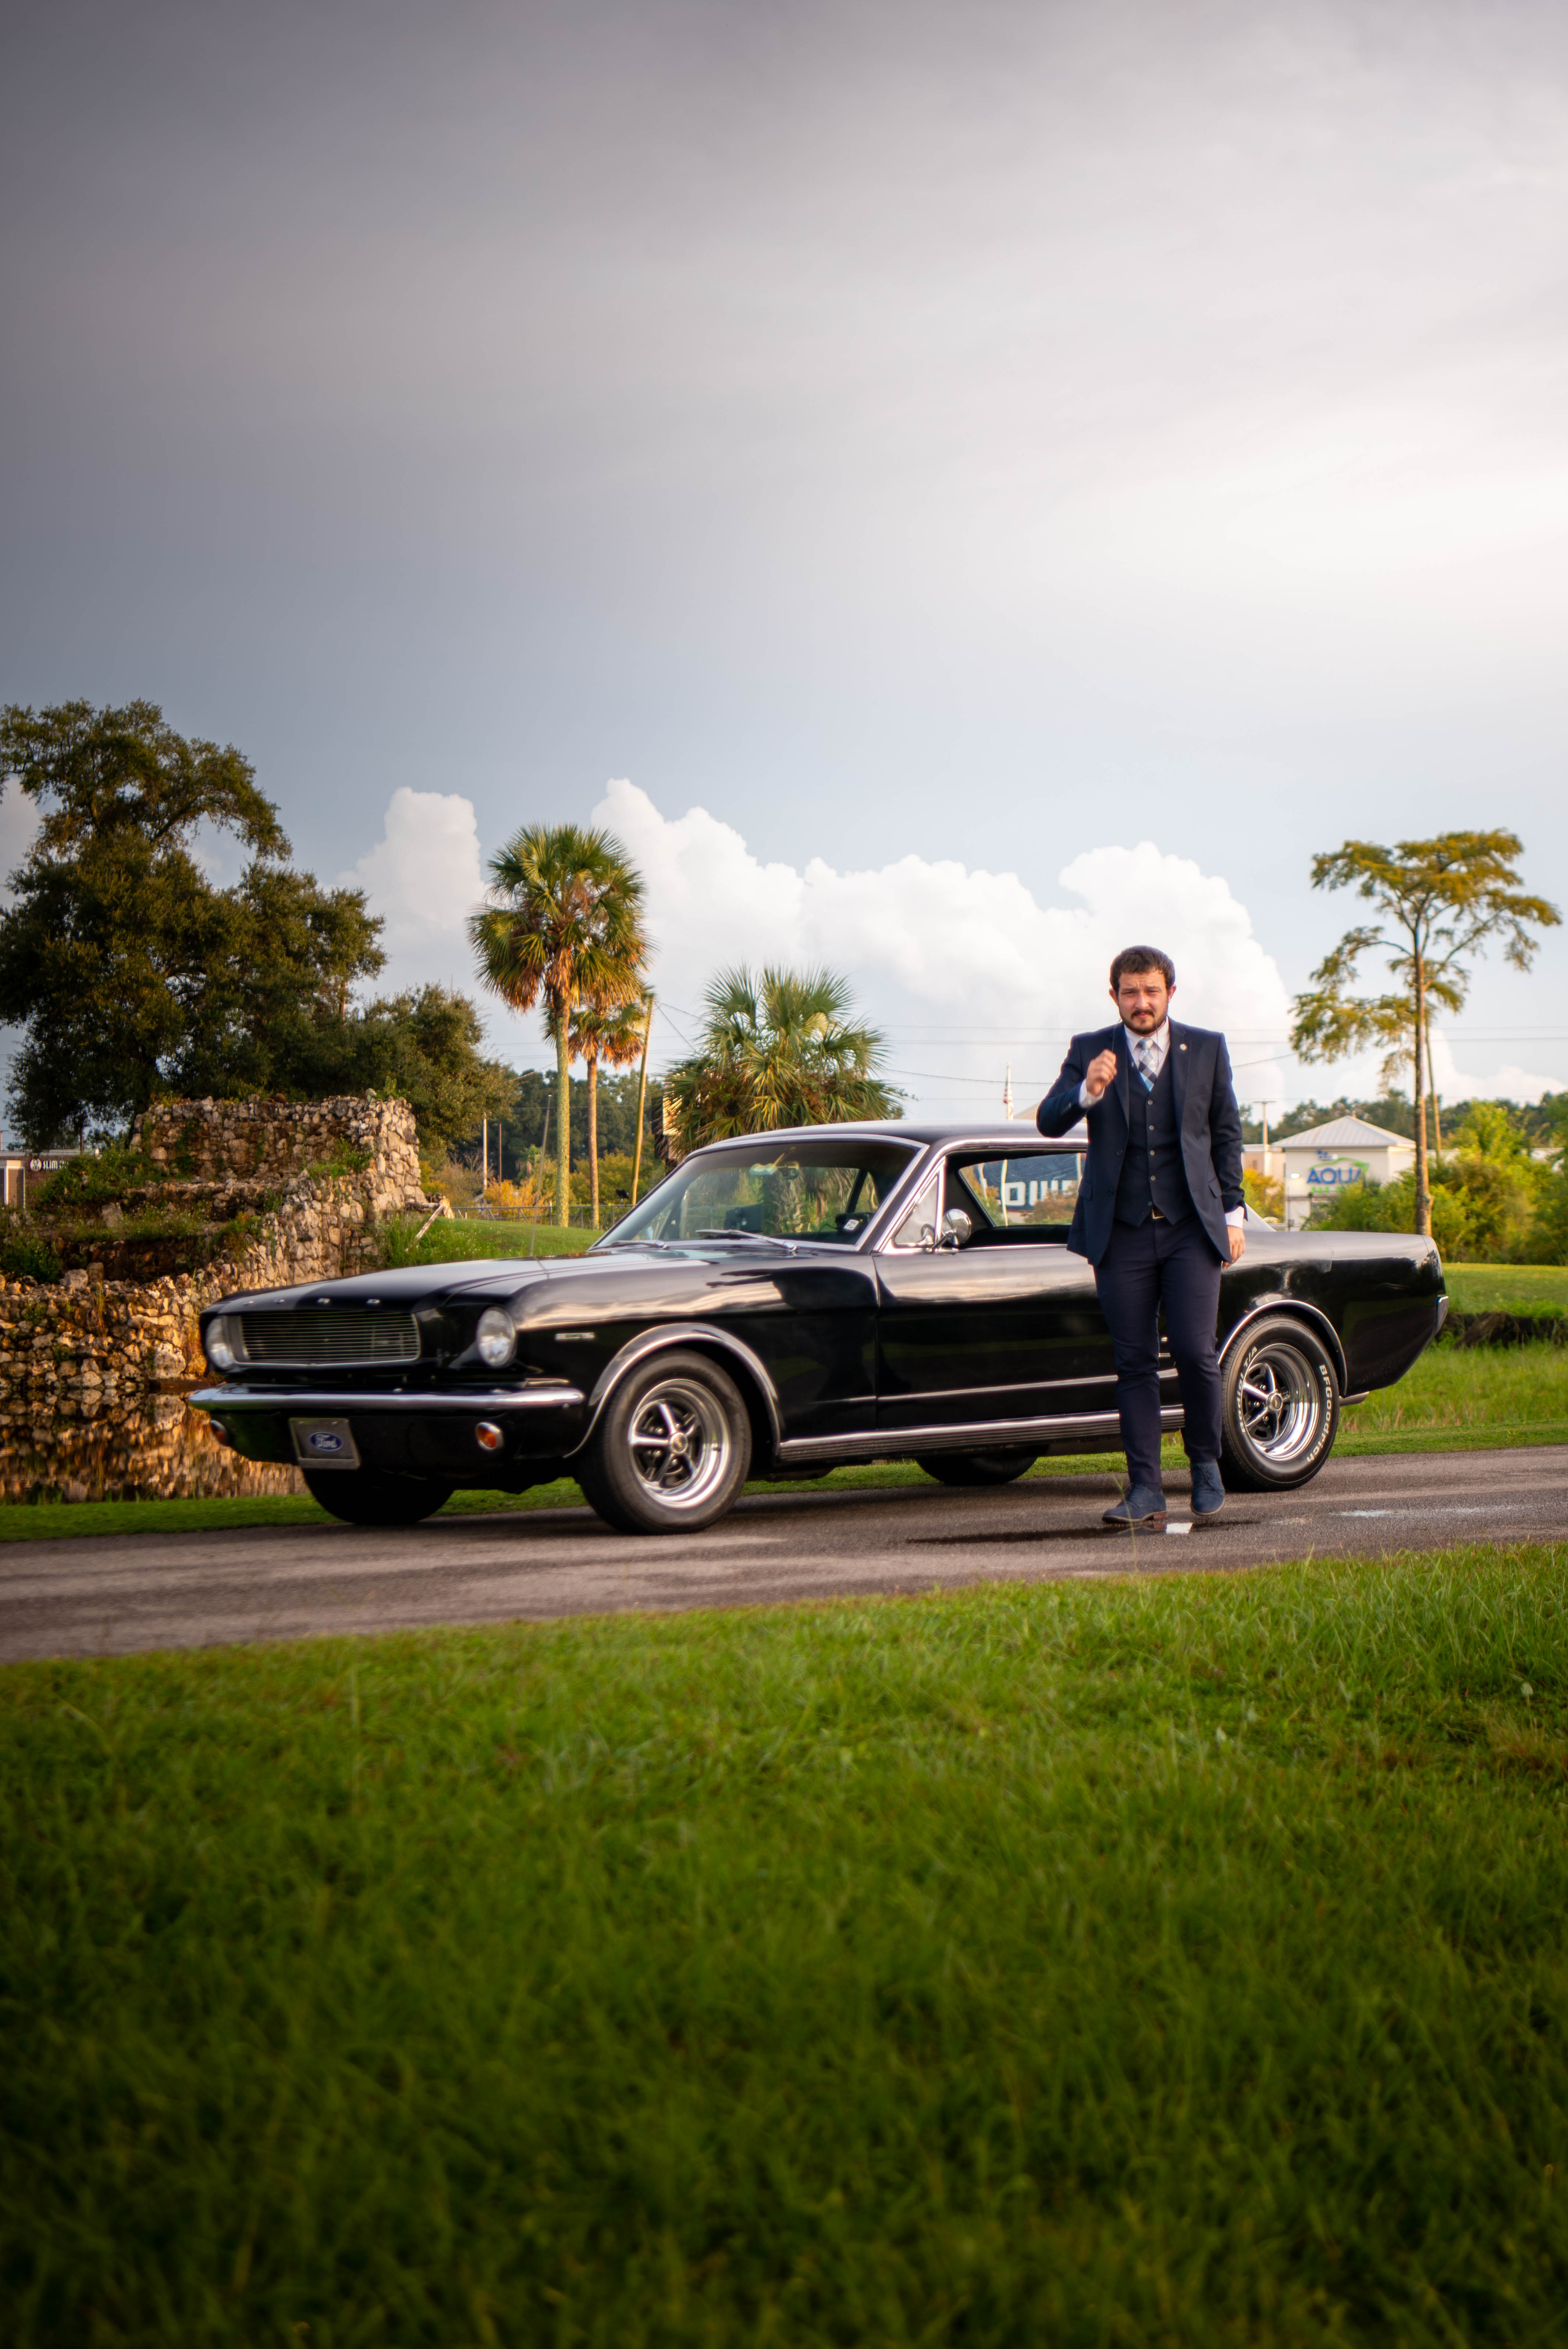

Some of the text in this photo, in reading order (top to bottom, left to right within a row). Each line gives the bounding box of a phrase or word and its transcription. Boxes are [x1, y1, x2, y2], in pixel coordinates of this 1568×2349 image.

[43, 1160, 58, 1168] SLIM
[1306, 1364, 1332, 1462] BFGoodrich
[315, 1434, 337, 1447] Ford
